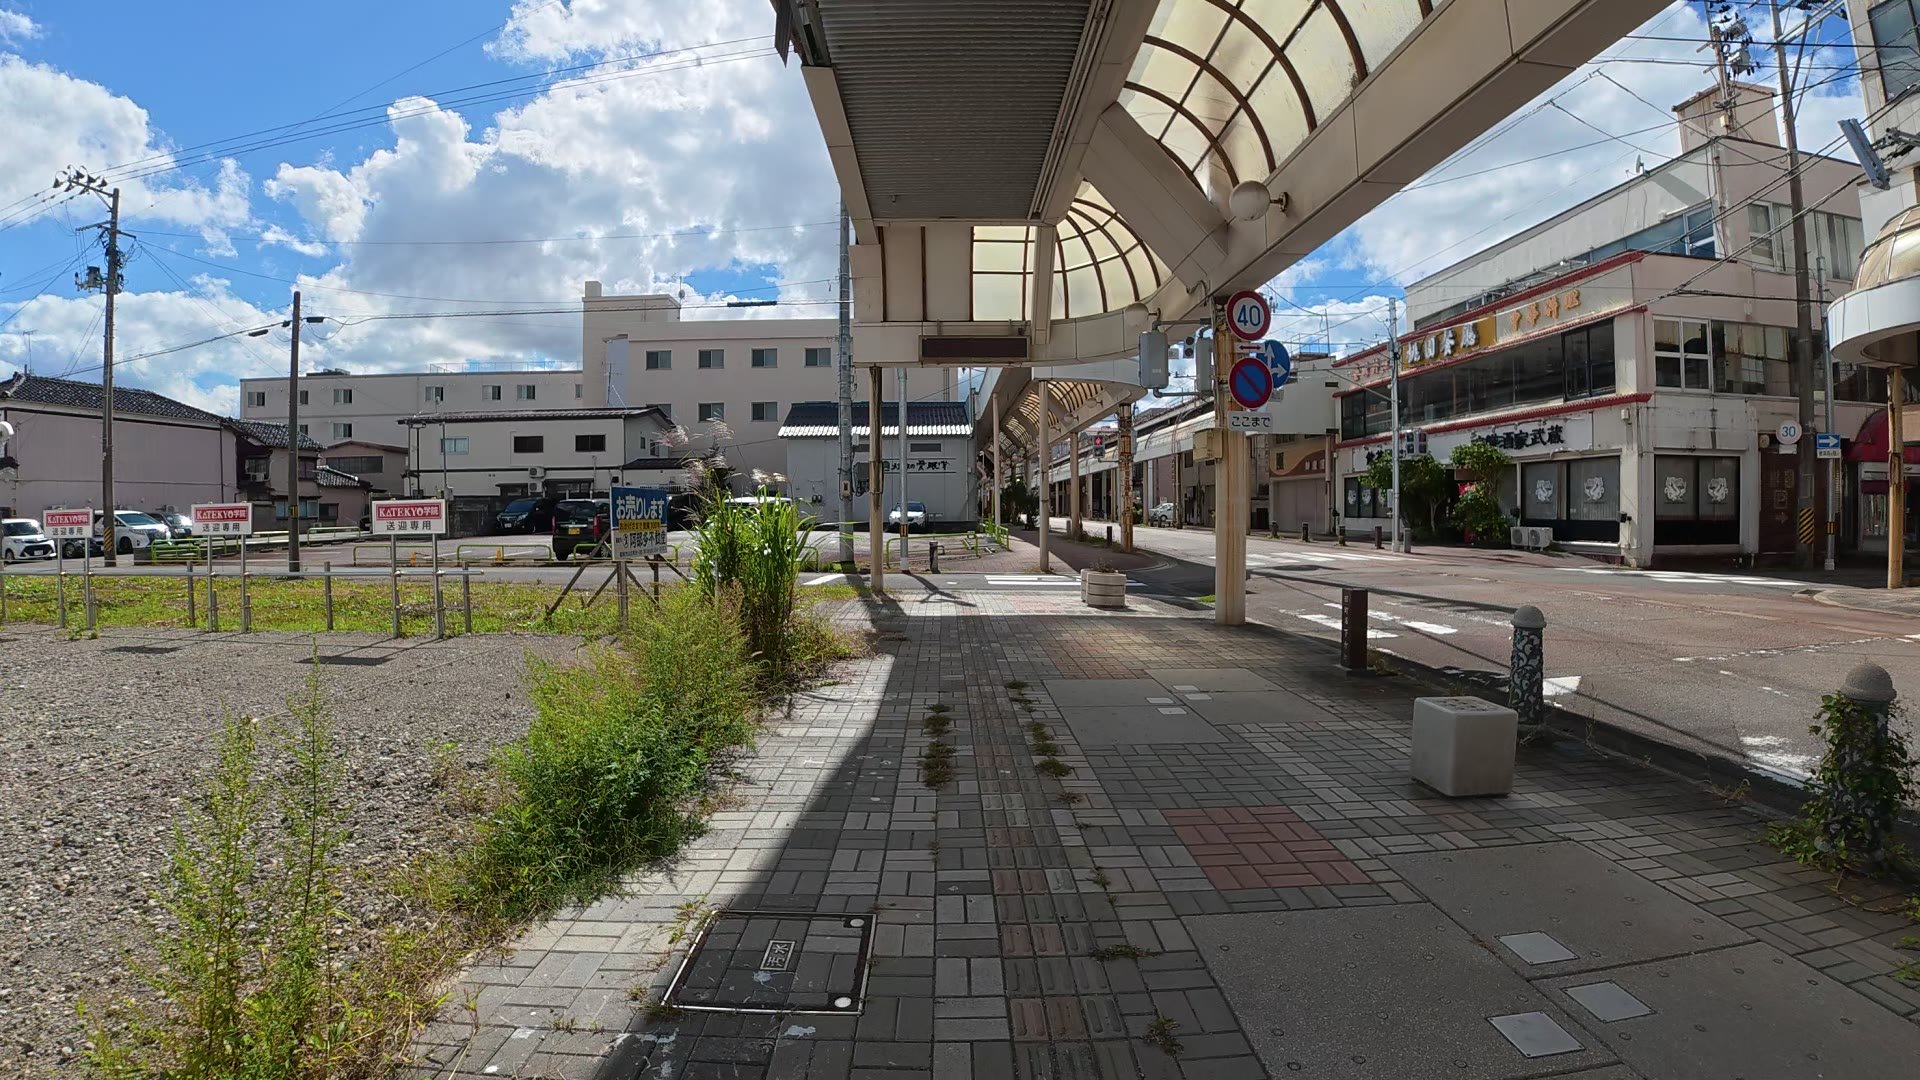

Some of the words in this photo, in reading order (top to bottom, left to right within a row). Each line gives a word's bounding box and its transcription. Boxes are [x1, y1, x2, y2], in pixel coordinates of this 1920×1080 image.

[1237, 304, 1261, 327] 40
[1231, 416, 1271, 428] ここまで
[1781, 425, 1797, 438] 30
[379, 507, 439, 517] KATEKYO学院
[616, 494, 665, 520] お売りします
[197, 509, 246, 519] KATEKYO学院
[386, 521, 431, 531] 送迎専用
[766, 943, 789, 968] 汚水
